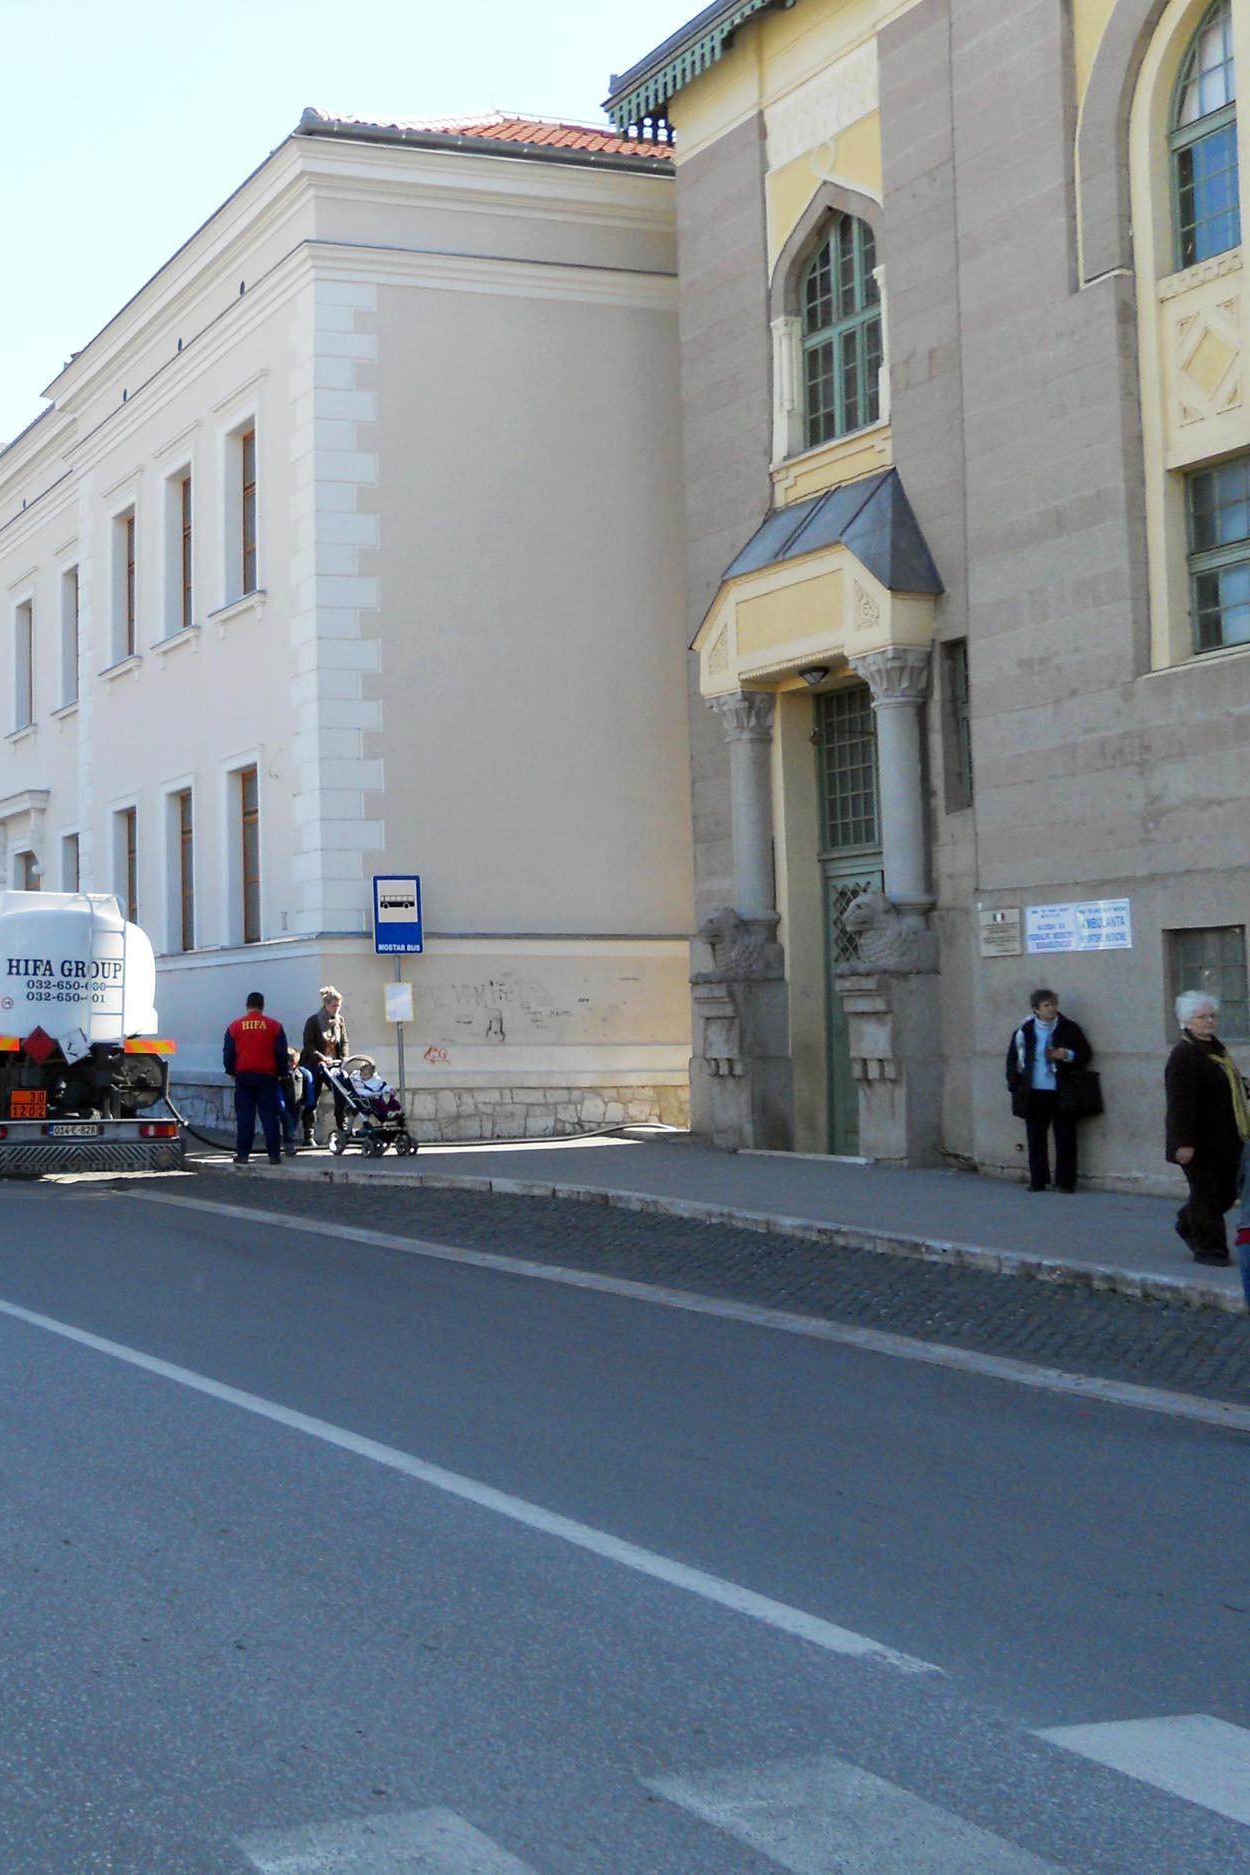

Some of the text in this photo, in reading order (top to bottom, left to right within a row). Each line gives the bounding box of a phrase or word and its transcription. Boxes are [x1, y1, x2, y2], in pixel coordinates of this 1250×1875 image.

[378, 943, 405, 951] MOSTAR
[7, 958, 122, 979] HIFA GROUP
[241, 1020, 267, 1031] HIFA
[30, 1091, 45, 1102] 30
[13, 1105, 45, 1117] 1202
